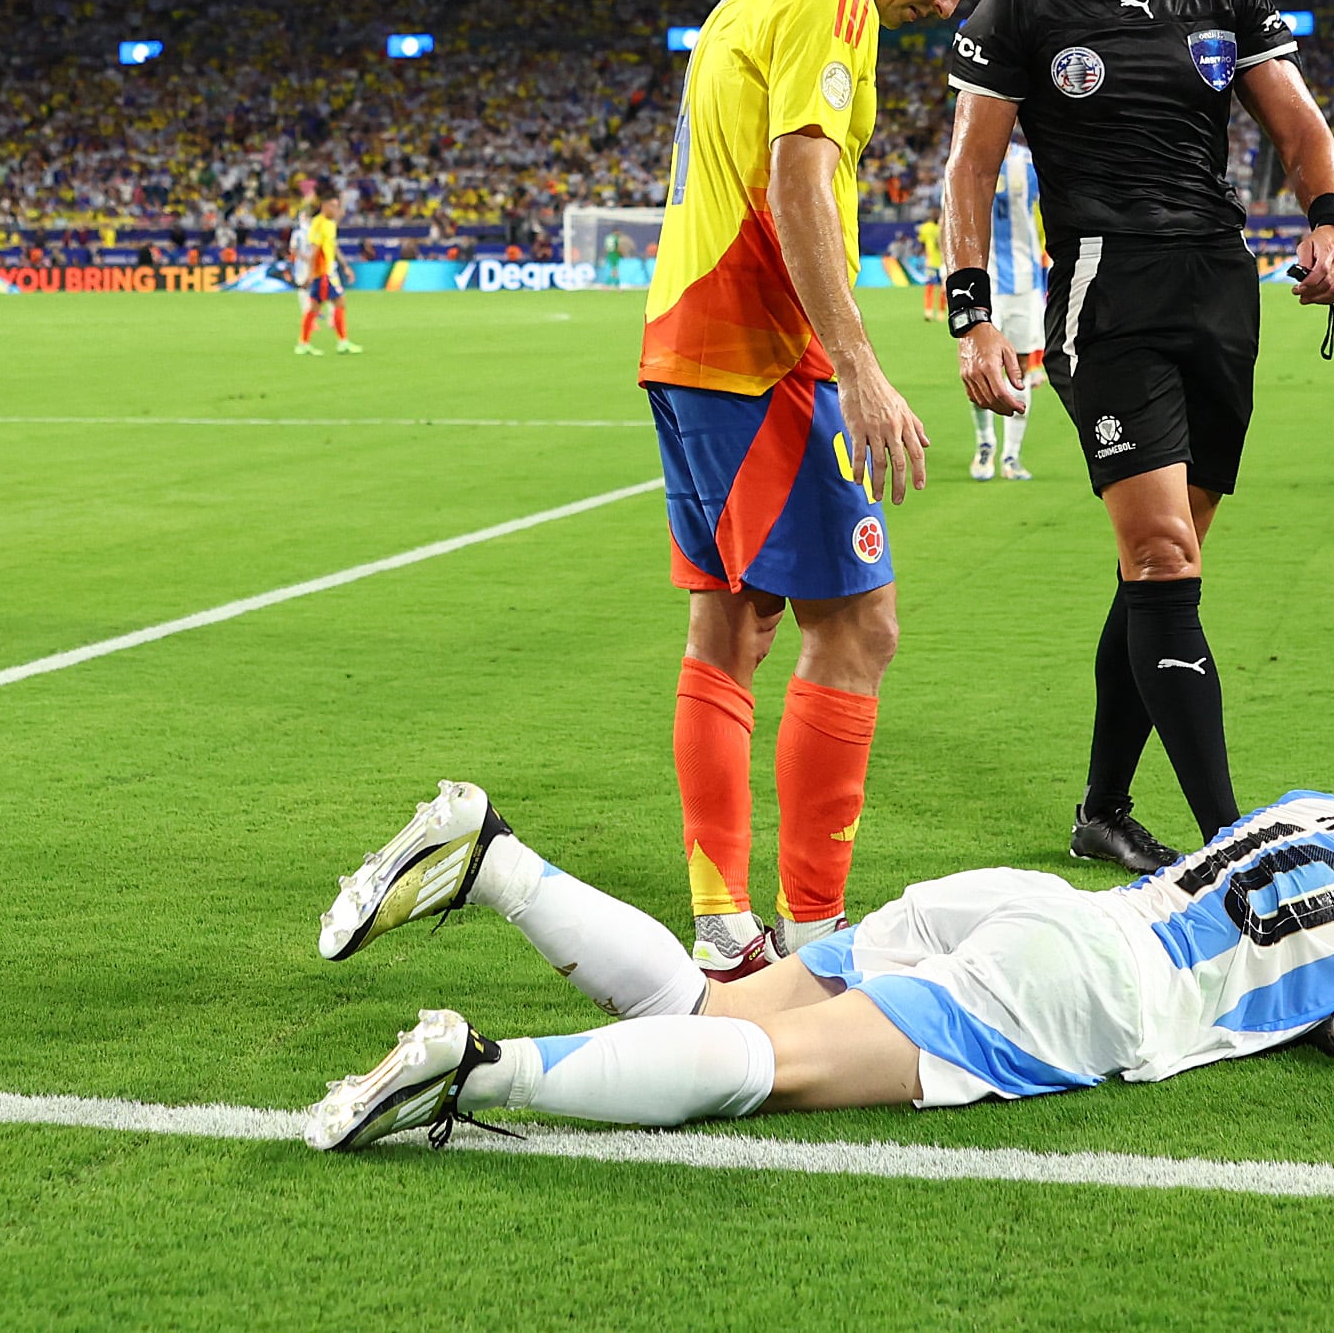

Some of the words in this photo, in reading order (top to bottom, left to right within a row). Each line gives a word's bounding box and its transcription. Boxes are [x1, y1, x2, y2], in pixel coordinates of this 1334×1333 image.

[952, 32, 990, 66] TCL
[65, 266, 156, 293] BRING
[159, 266, 220, 293] THE
[479, 259, 596, 291] Degree
[1097, 442, 1137, 460] CONMEBOL
